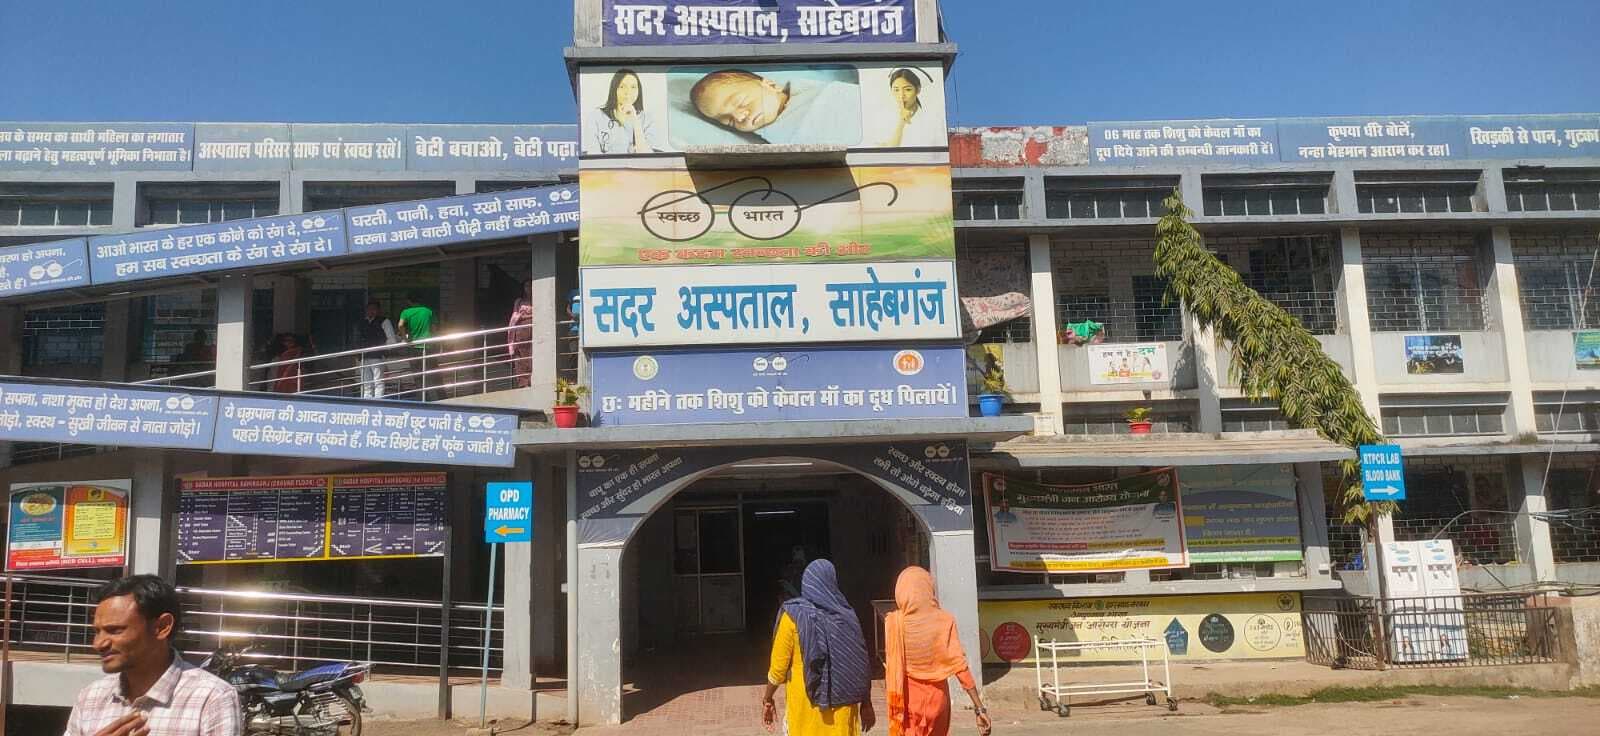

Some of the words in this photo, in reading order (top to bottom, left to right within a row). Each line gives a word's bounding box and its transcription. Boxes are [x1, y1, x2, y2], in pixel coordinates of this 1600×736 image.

[614, 5, 666, 36] सदर
[797, 0, 904, 36] साहेबगंज
[14, 128, 25, 143] के
[27, 131, 52, 143] समय
[54, 131, 68, 143] का
[98, 129, 129, 144] महिला
[131, 132, 145, 144] का
[147, 132, 185, 144] लगातार
[1104, 129, 1120, 140] 06
[1122, 128, 1141, 140] माह
[1144, 129, 1160, 140] तक
[1162, 126, 1186, 142] शिशु
[1187, 124, 1201, 138] को
[1203, 124, 1231, 138] केवल
[1247, 127, 1262, 138] का
[1327, 125, 1361, 141] कृपया
[1470, 127, 1515, 148] खिड़की
[1516, 126, 1529, 144] से
[107, 148, 140, 166] भूमिका
[199, 142, 252, 159] अस्पताल
[254, 138, 291, 159] परिसर
[293, 142, 321, 159] साफ
[322, 137, 343, 159] एवं
[343, 142, 374, 159] स्वच्छ
[415, 136, 444, 157] बेटी
[514, 136, 544, 157] बेटी
[547, 140, 579, 161] पढ़ा
[1135, 144, 1158, 157] जाने
[1160, 143, 1174, 157] की
[1215, 142, 1258, 155] जानकारी
[1298, 146, 1325, 159] नन्हा
[1327, 143, 1367, 158] मेहमान
[1370, 144, 1406, 158] आराम
[1407, 144, 1425, 157] कर
[472, 197, 502, 214] रखो
[657, 210, 700, 224] स्वच्छ
[743, 210, 784, 222] भारत
[352, 232, 387, 245] वरना
[390, 226, 418, 242] आने
[421, 221, 452, 237] वाली
[484, 215, 511, 231] नहीं
[512, 211, 550, 228] करेंगी
[97, 240, 127, 259] आओ
[129, 239, 158, 254] भारत
[161, 234, 174, 250] के
[177, 235, 194, 250] हर
[195, 233, 216, 248] एक
[218, 225, 245, 243] कोने
[247, 224, 264, 240] को
[266, 222, 284, 239] रंग
[22, 249, 34, 262] हो
[115, 261, 139, 277] हम
[143, 258, 168, 272] सब
[170, 251, 223, 268] स्वच्छता
[226, 245, 242, 261] के
[246, 243, 268, 260] रंग
[271, 240, 286, 257] से
[288, 238, 311, 255] रंग
[590, 287, 656, 338] सदर
[677, 284, 809, 335] अस्पताल,
[825, 267, 947, 332] साहेबगंज
[42, 393, 66, 407] नशा
[66, 394, 94, 415] मुक्त
[95, 393, 108, 410] हो
[110, 393, 128, 410] देश
[627, 389, 672, 411] महीने
[676, 393, 704, 410] तक
[707, 388, 745, 415] शिशु
[747, 387, 769, 408] को
[773, 386, 816, 407] केवल
[843, 389, 865, 406] का
[869, 389, 894, 411] दूध
[26, 415, 56, 428] स्वस्थ
[68, 412, 94, 436] सुखी
[96, 413, 128, 432] जीवन
[129, 416, 141, 433] से
[143, 420, 168, 434] नाता
[224, 402, 235, 419] ये
[278, 404, 294, 422] की
[296, 410, 328, 424] आदत
[329, 409, 370, 426] आसानी
[372, 410, 384, 427] से
[411, 416, 427, 435] छूट
[428, 413, 451, 430] पाती
[232, 425, 261, 443] पहले
[295, 431, 314, 445] हम
[366, 430, 388, 449] फिर
[467, 436, 493, 454] जाती
[1363, 453, 1385, 465] RTPCR
[1386, 453, 1400, 465] LAB
[1365, 470, 1383, 481] BLOOD
[1385, 469, 1401, 481] BANK
[500, 488, 520, 503] OPD
[488, 507, 529, 520] PHARMACY
